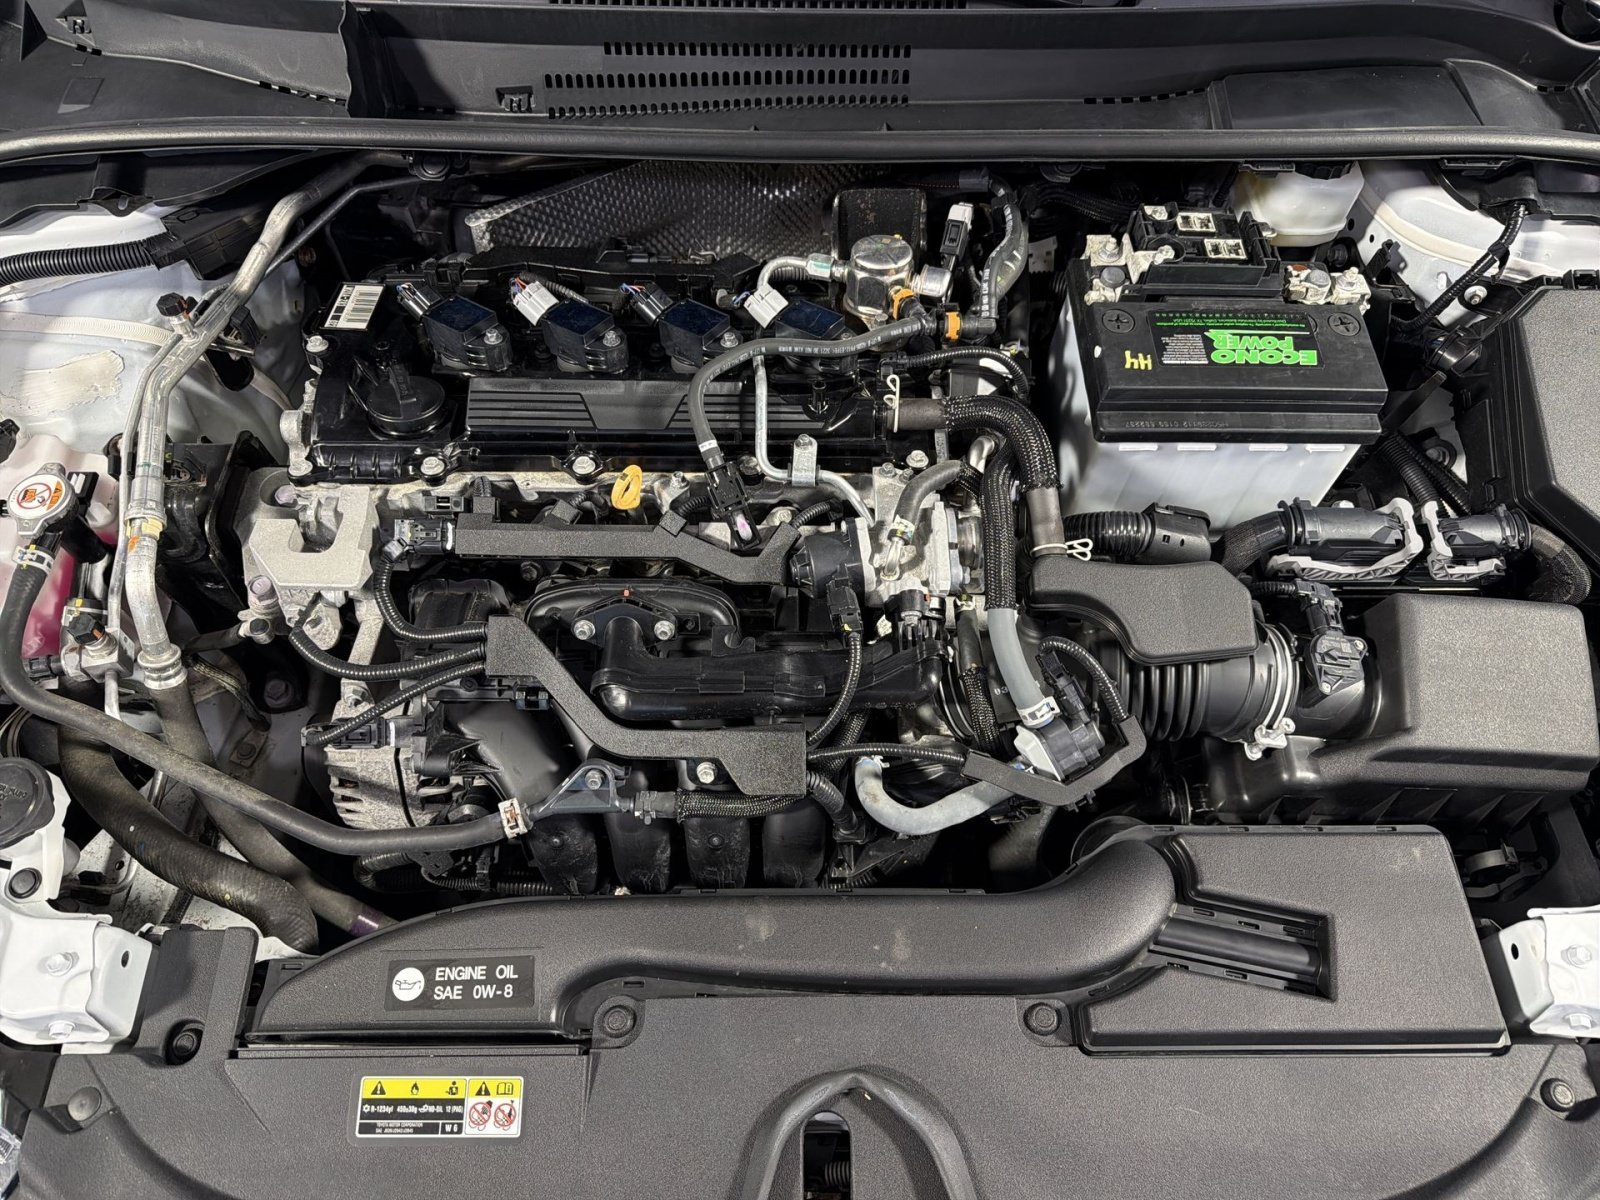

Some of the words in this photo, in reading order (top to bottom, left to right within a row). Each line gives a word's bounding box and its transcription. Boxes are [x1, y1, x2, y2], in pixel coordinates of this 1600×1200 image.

[1211, 333, 1294, 350] POWER
[1123, 350, 1153, 371] H4
[1211, 349, 1318, 366] ECONO
[435, 966, 487, 981] ENGINE
[495, 964, 519, 979] OIL
[433, 985, 463, 1001] SAE
[473, 984, 513, 999] 0W-8
